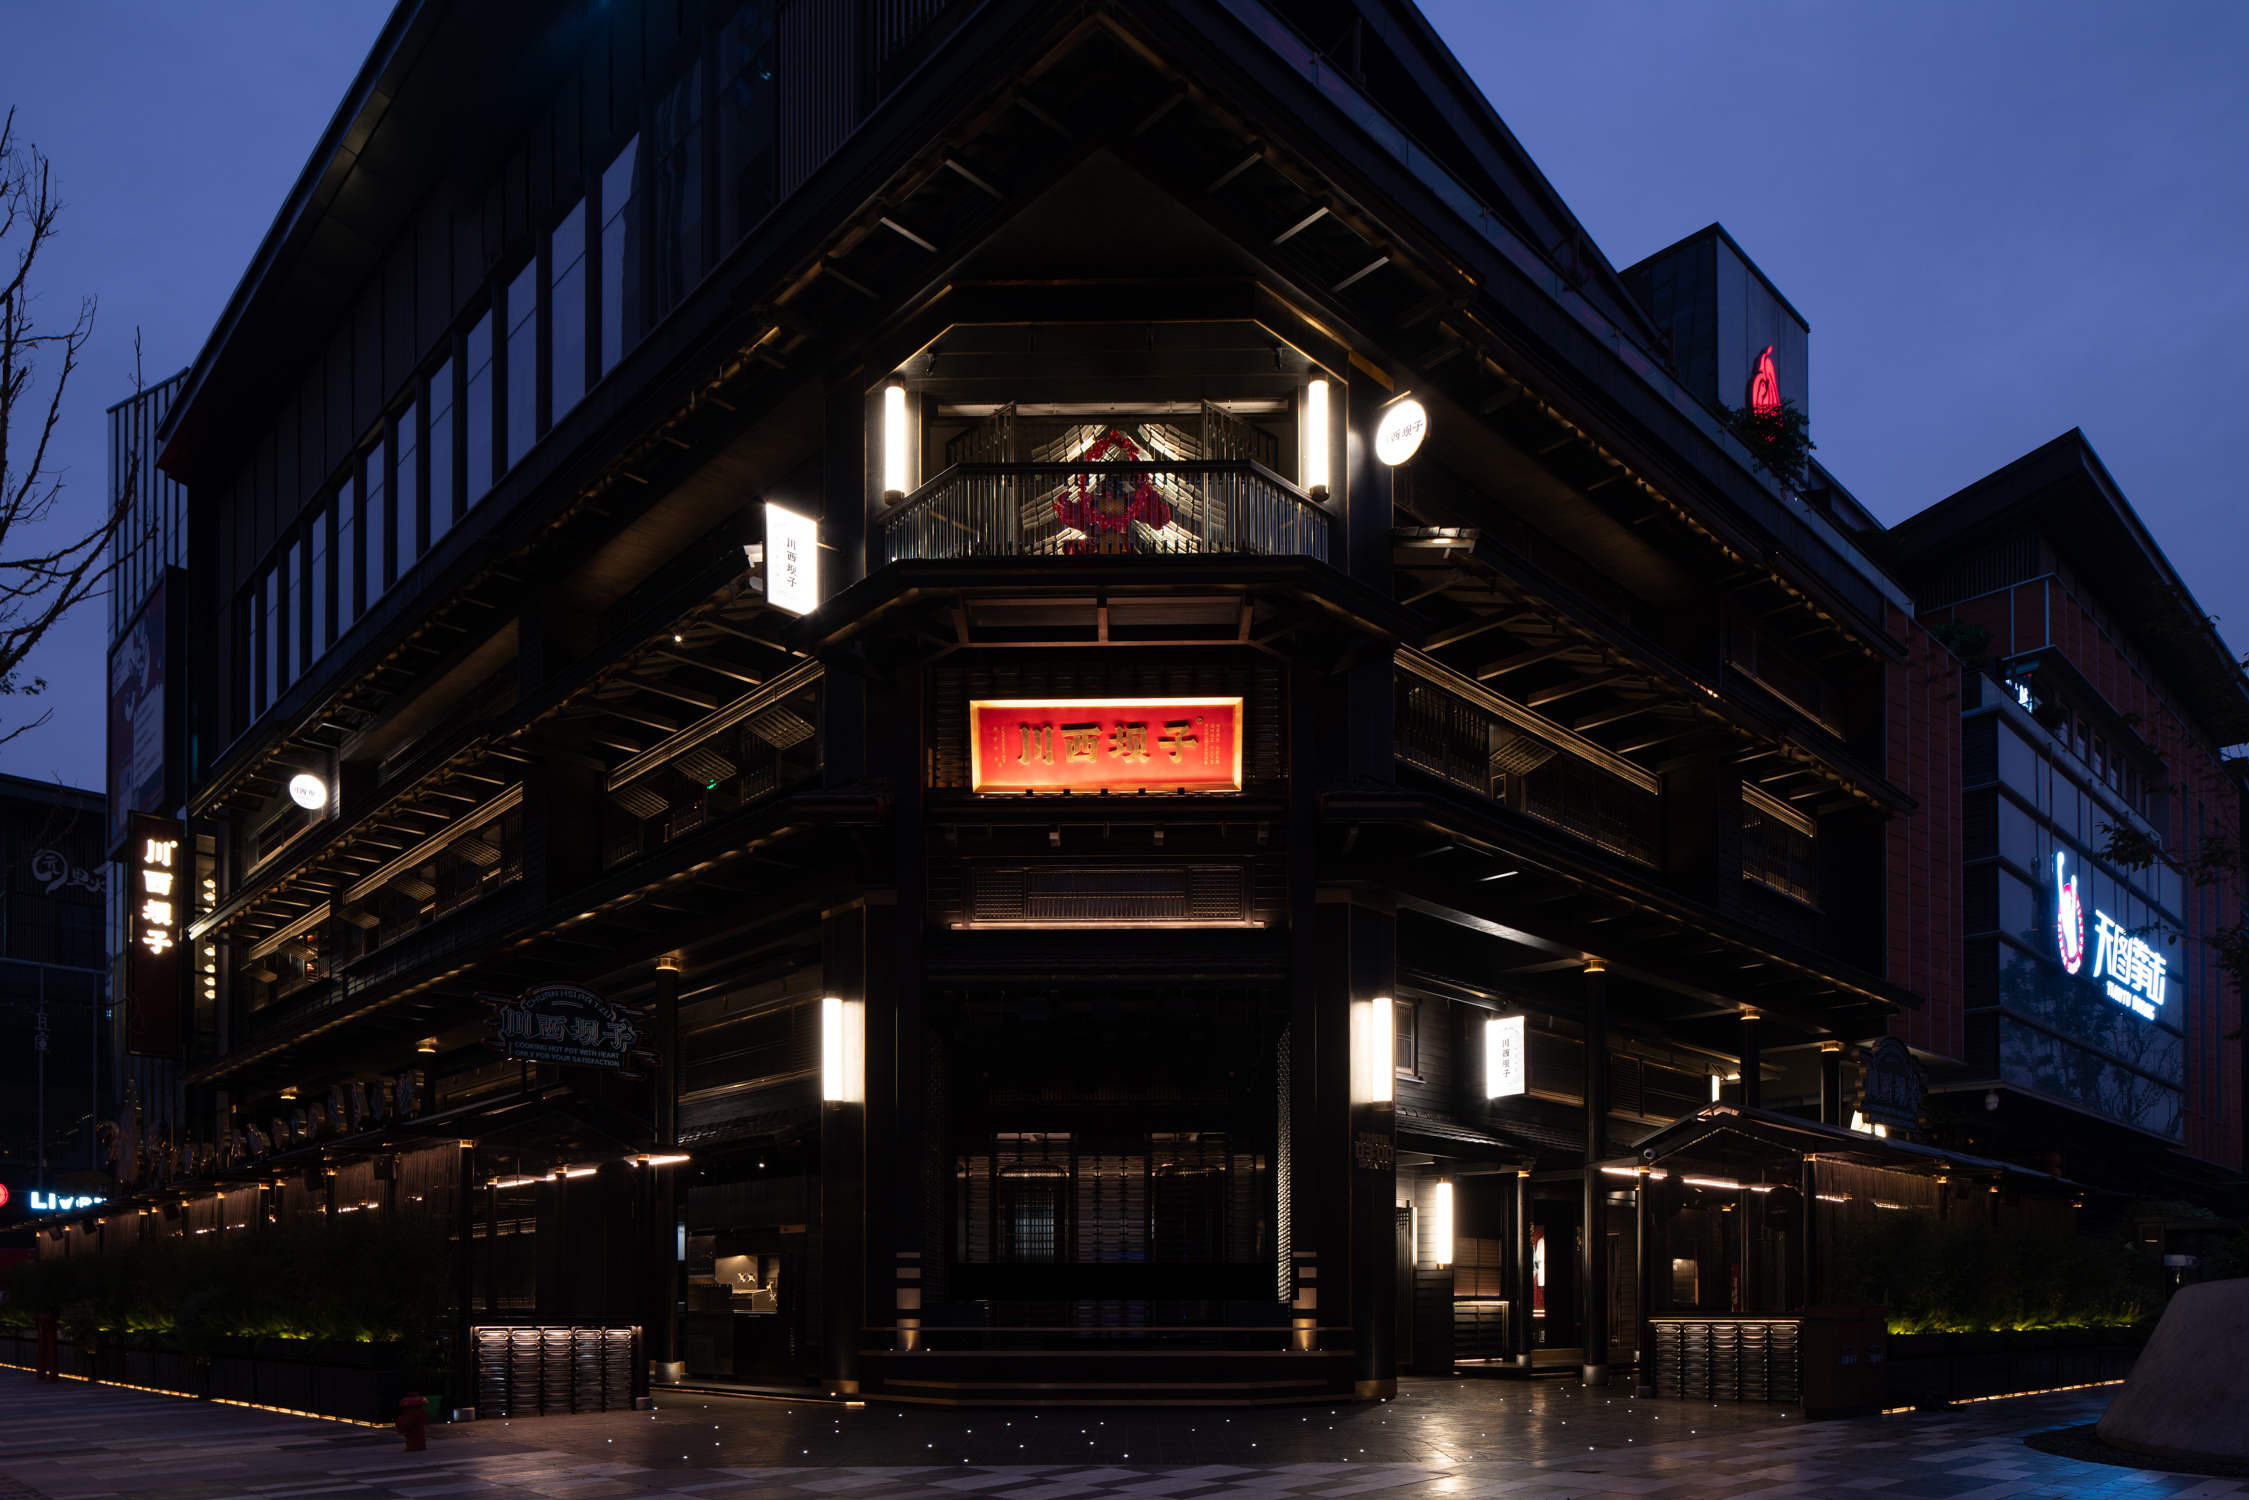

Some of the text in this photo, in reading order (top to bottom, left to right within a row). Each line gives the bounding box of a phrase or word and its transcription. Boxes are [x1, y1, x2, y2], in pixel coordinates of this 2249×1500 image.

[786, 537, 798, 588] 川西坝子
[1018, 721, 1198, 765] 川西坝子
[142, 838, 174, 955] 川西坝子
[525, 989, 612, 1019] CHUAN HSI PA TZU
[499, 1008, 635, 1050] 川西坝子
[514, 1041, 620, 1060] COOKING HOT POT WITH HEART
[514, 1050, 620, 1067] ONLY FOR YOUR SATISFACTION
[1501, 1038, 1511, 1078] 川西坝子
[1867, 1070, 1919, 1110] 川西坝子
[1354, 1141, 1395, 1162] 03:00
[1358, 1158, 1379, 1170] OPEN
